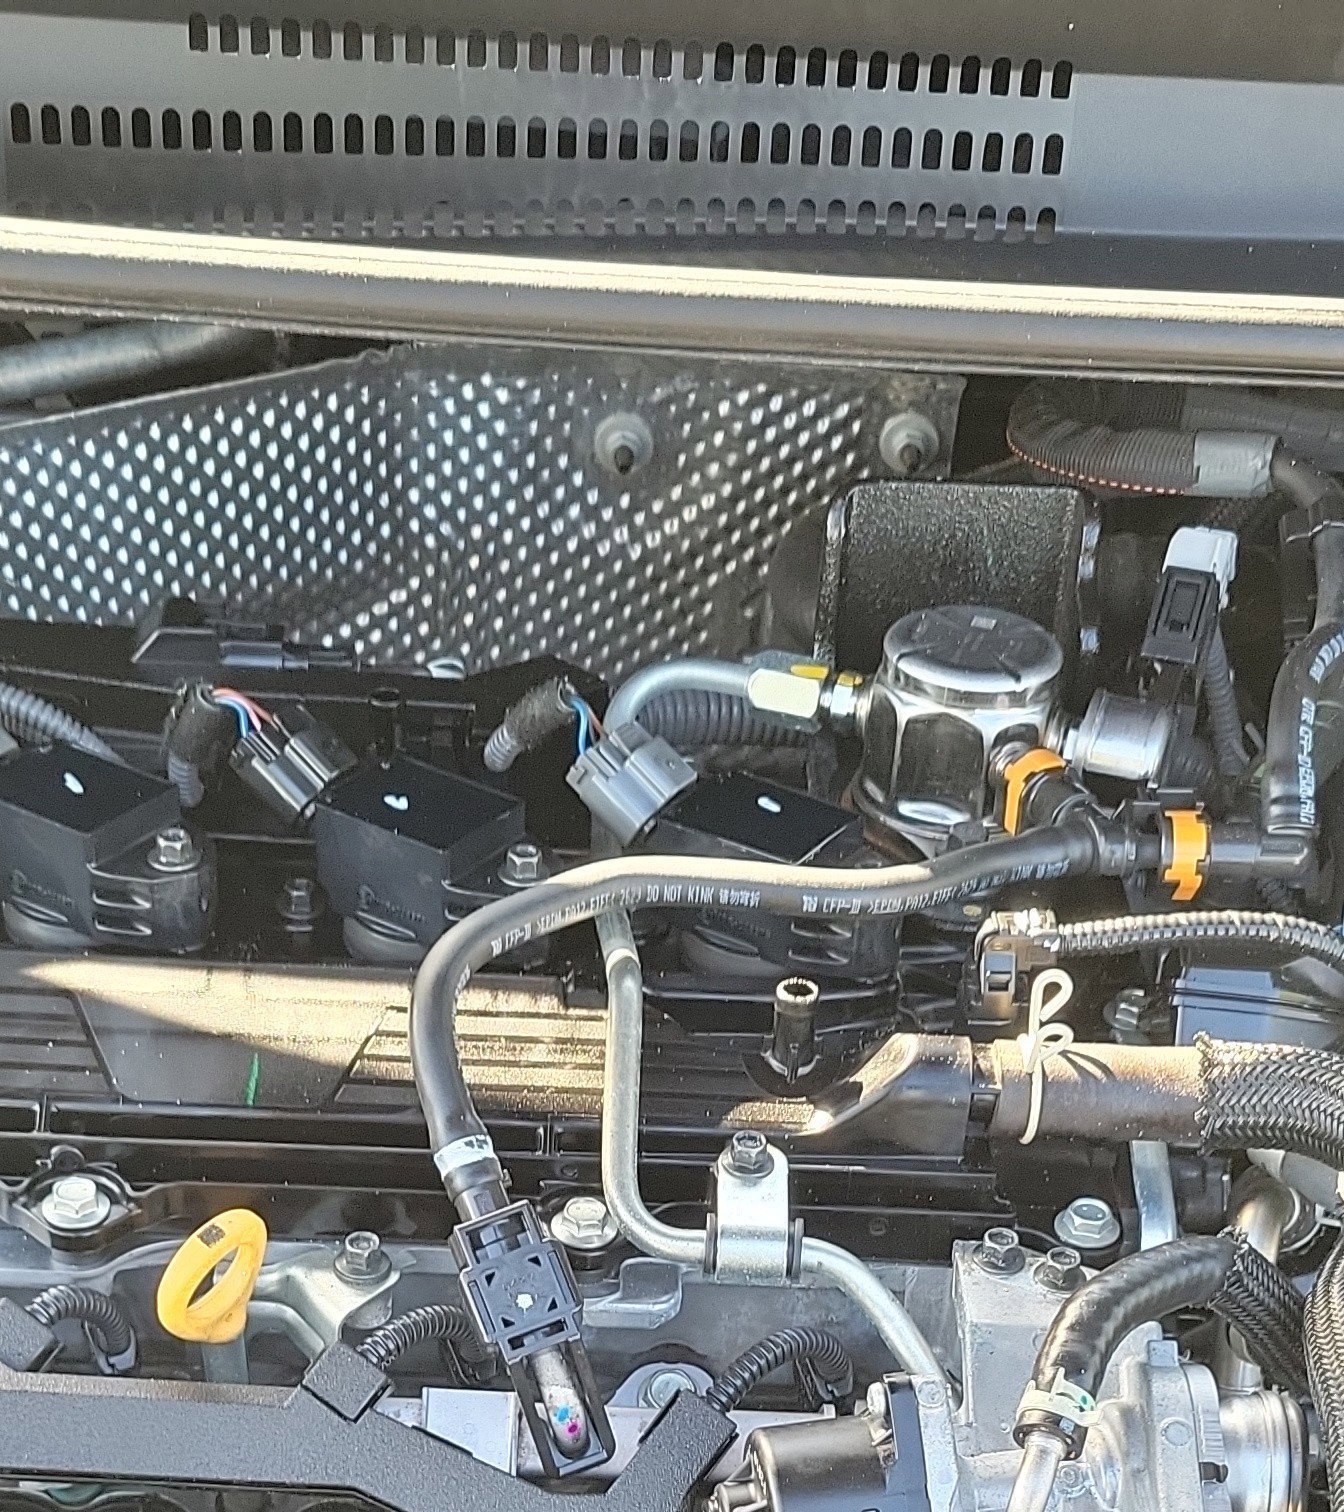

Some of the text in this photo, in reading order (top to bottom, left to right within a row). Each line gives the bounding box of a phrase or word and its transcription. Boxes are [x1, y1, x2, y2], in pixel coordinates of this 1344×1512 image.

[646, 884, 661, 903] DO
[663, 884, 683, 903] NOT
[687, 885, 714, 904] KINK
